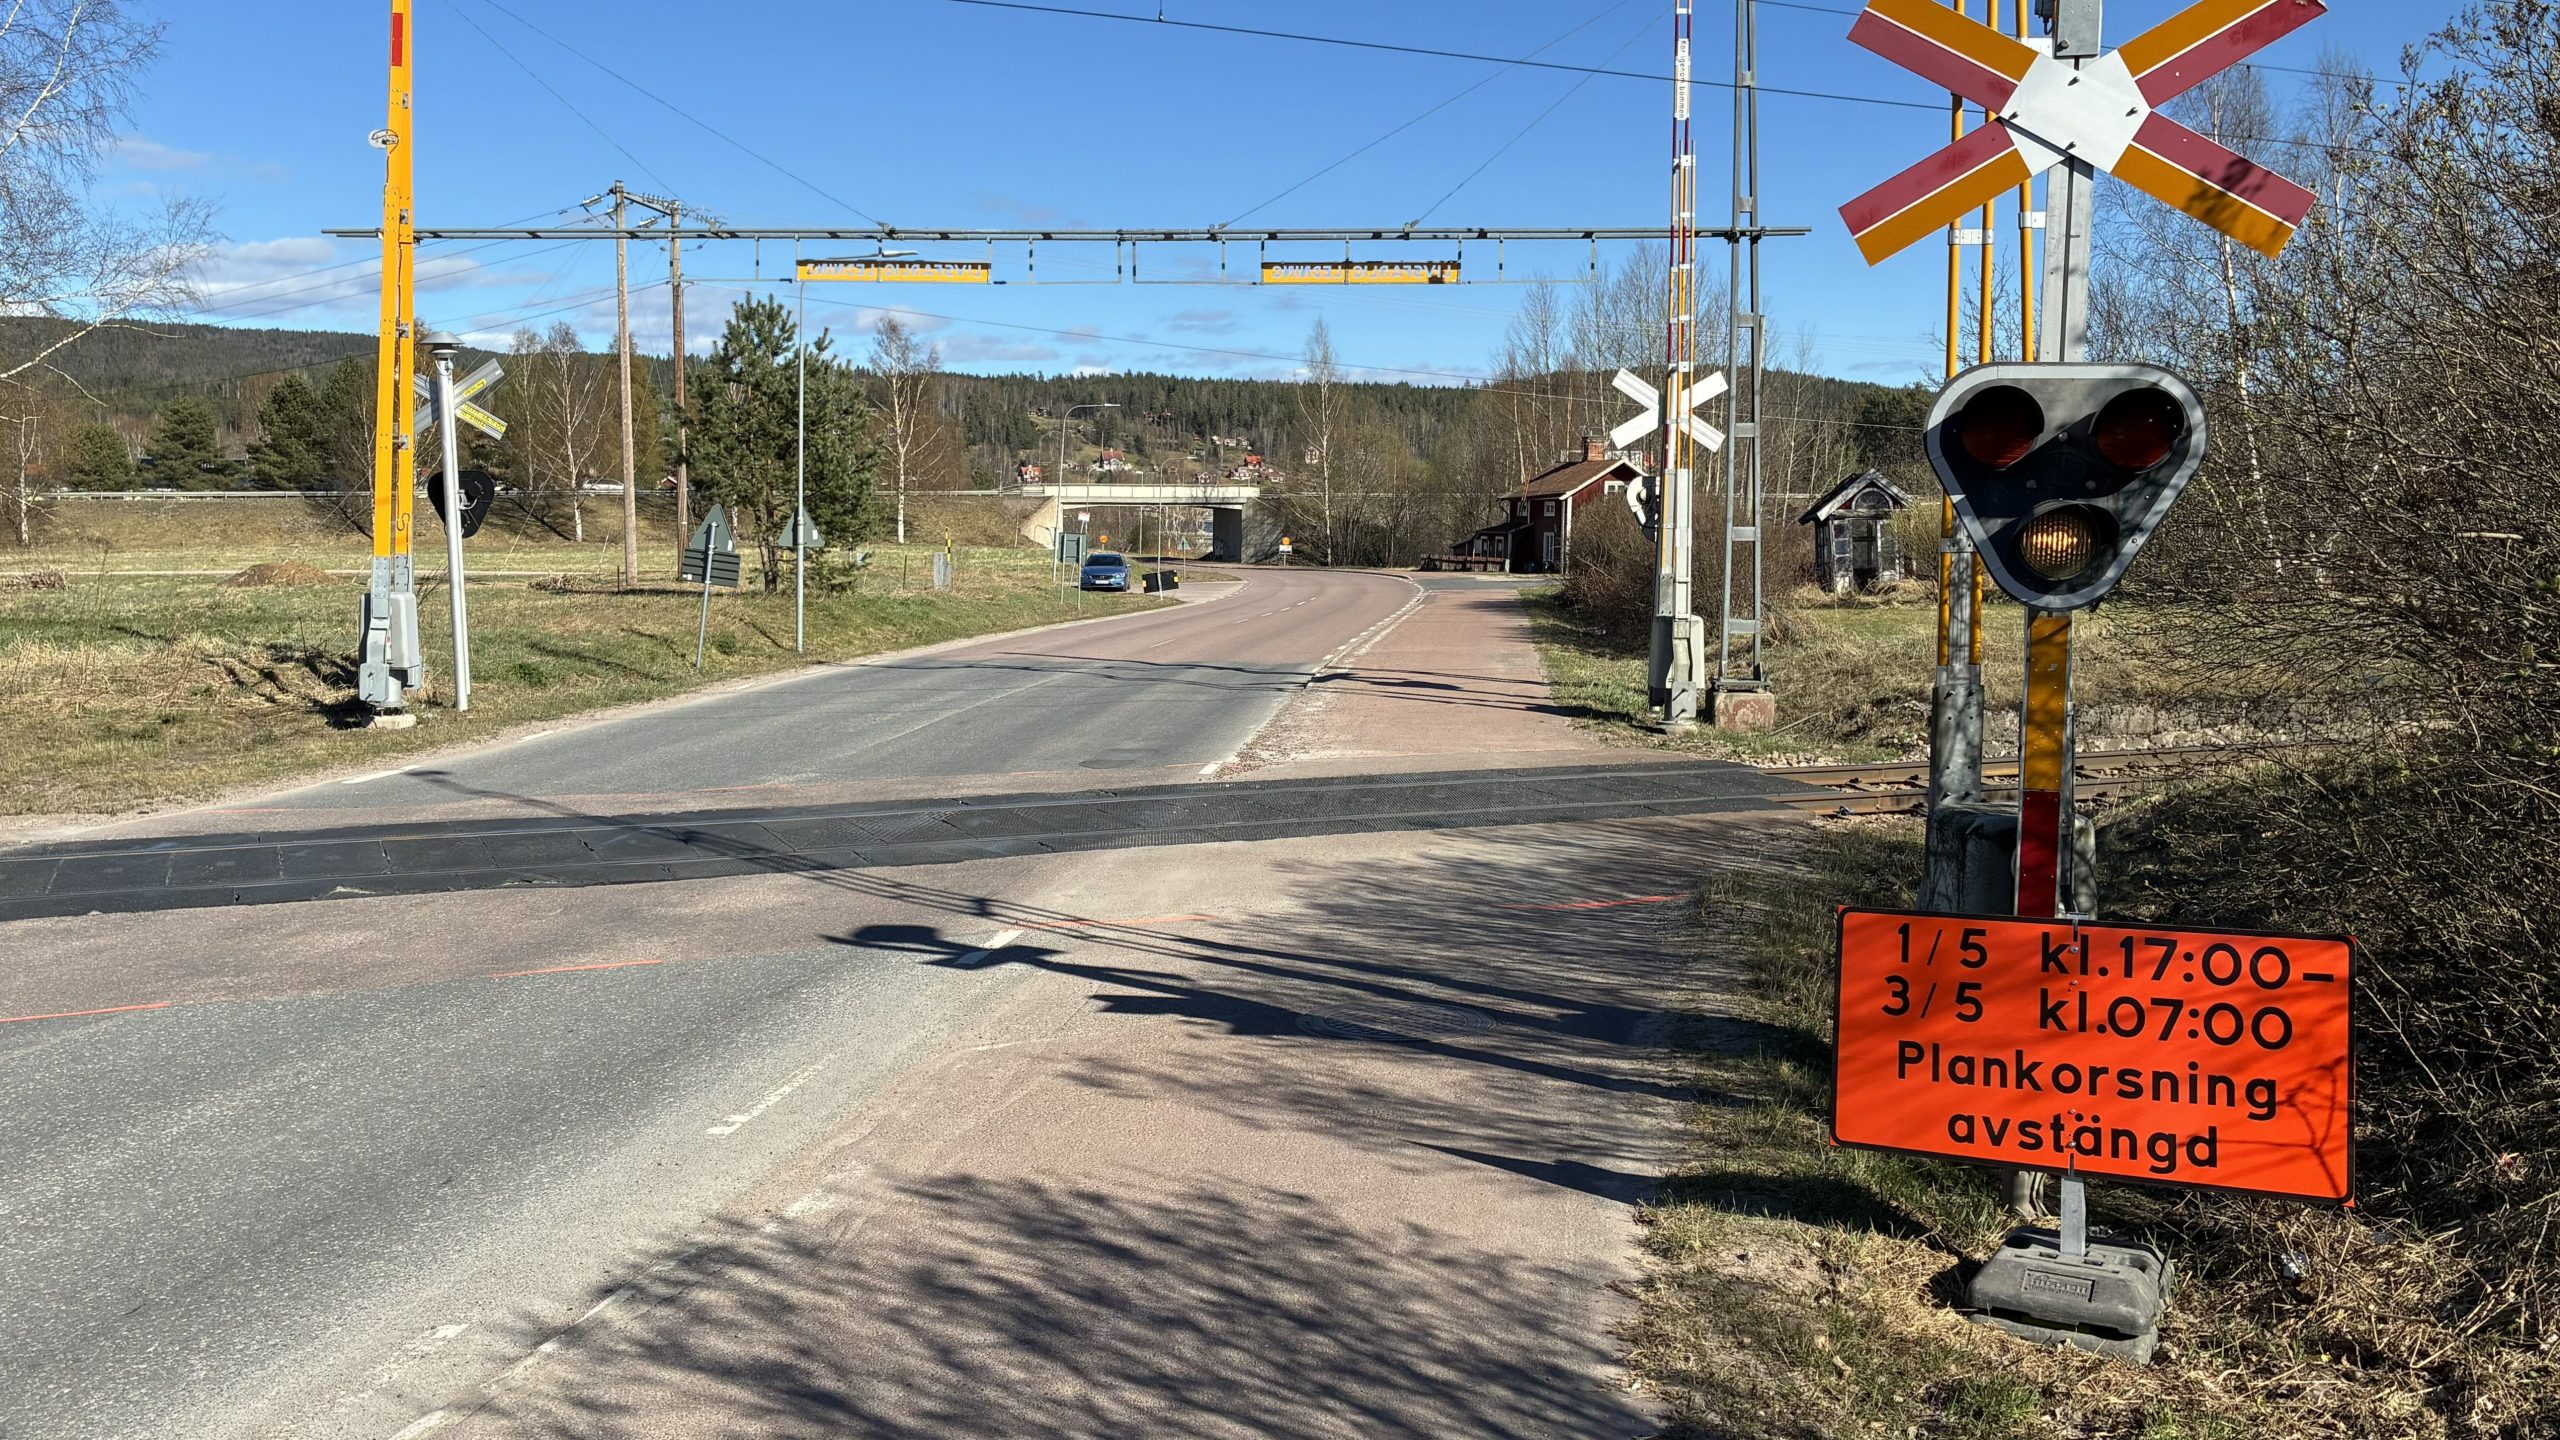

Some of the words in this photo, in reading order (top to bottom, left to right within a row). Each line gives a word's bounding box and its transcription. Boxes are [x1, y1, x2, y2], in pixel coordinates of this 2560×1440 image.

[2039, 987, 2293, 1051] kl.07:00
[1898, 1040, 2278, 1121] Plankorsning
[1947, 1113, 2218, 1175] avstängd
